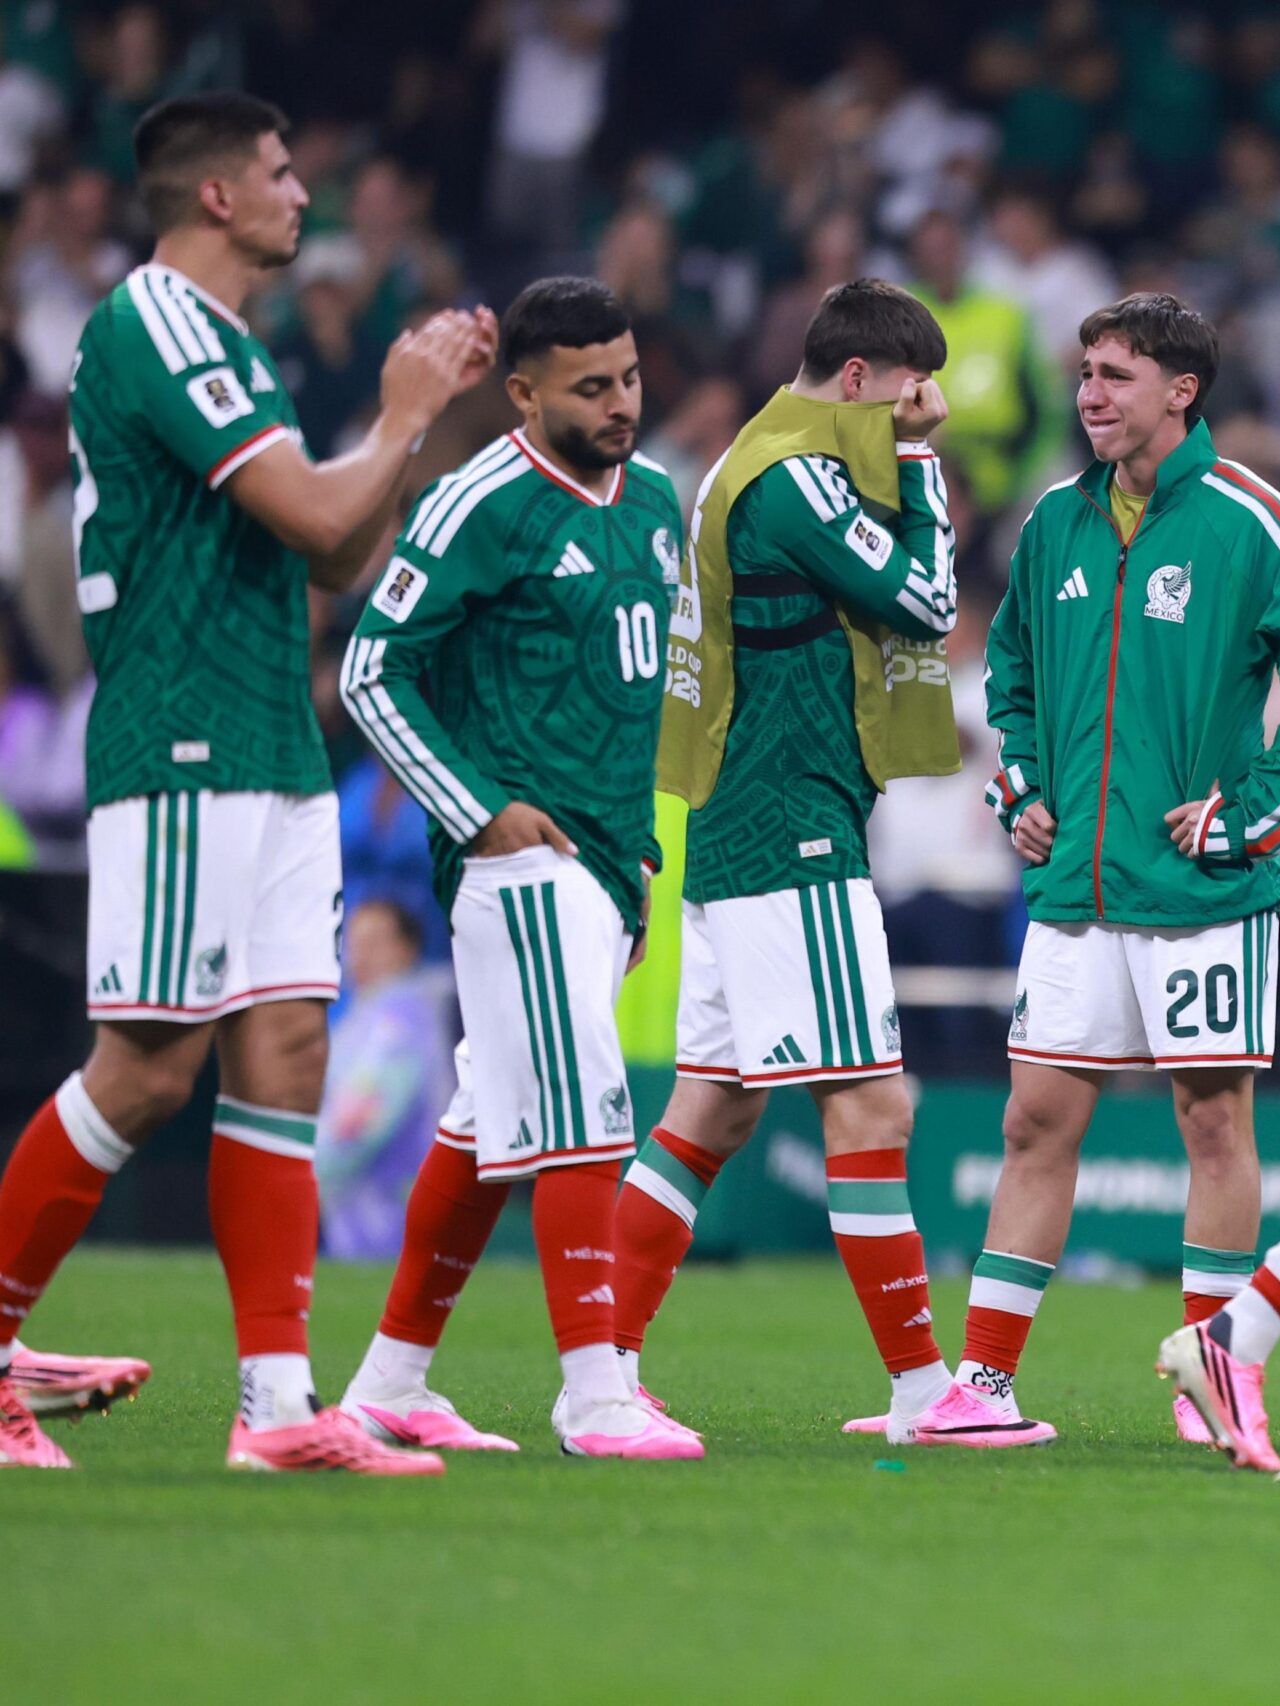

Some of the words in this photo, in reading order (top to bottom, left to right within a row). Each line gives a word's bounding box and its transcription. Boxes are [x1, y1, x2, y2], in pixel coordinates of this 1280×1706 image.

[615, 601, 659, 682] 10
[885, 654, 950, 693] 202
[1166, 963, 1238, 1038] 20
